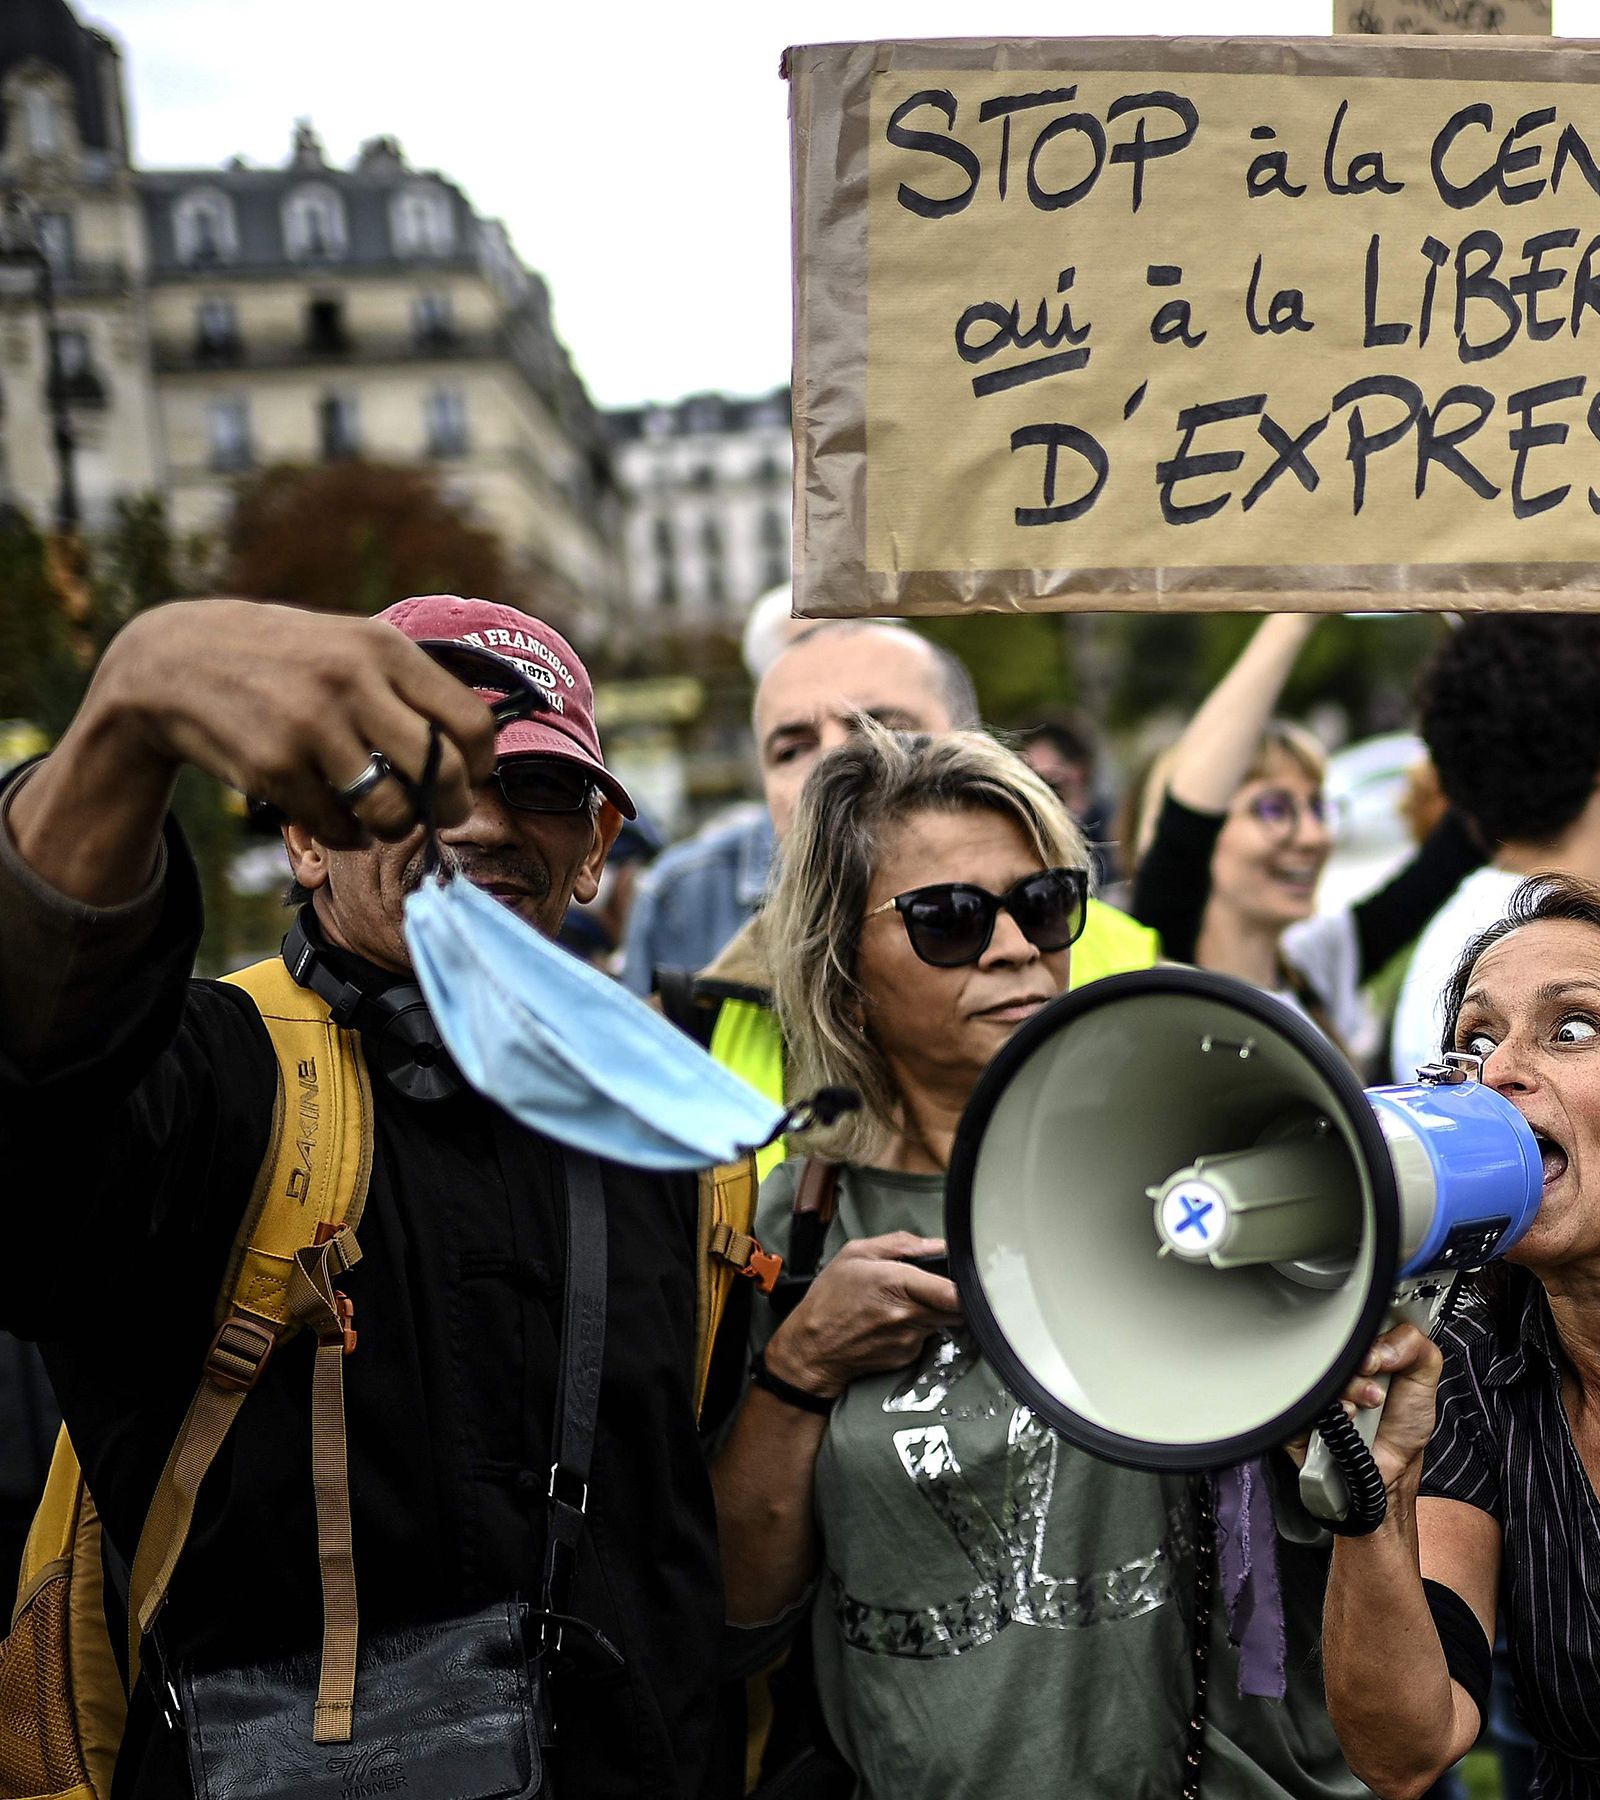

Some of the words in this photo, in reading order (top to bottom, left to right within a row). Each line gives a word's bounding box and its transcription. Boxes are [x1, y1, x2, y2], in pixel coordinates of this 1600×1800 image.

[886, 85, 1200, 219] STOP
[1247, 126, 1307, 199] à
[1323, 98, 1406, 198] la
[955, 266, 1092, 364] oui
[1147, 264, 1206, 349] à
[1245, 253, 1313, 336] la
[484, 629, 576, 689] FRANCISCO
[286, 1056, 321, 1207] DAKINE
[340, 1778, 408, 1800] WINNER
